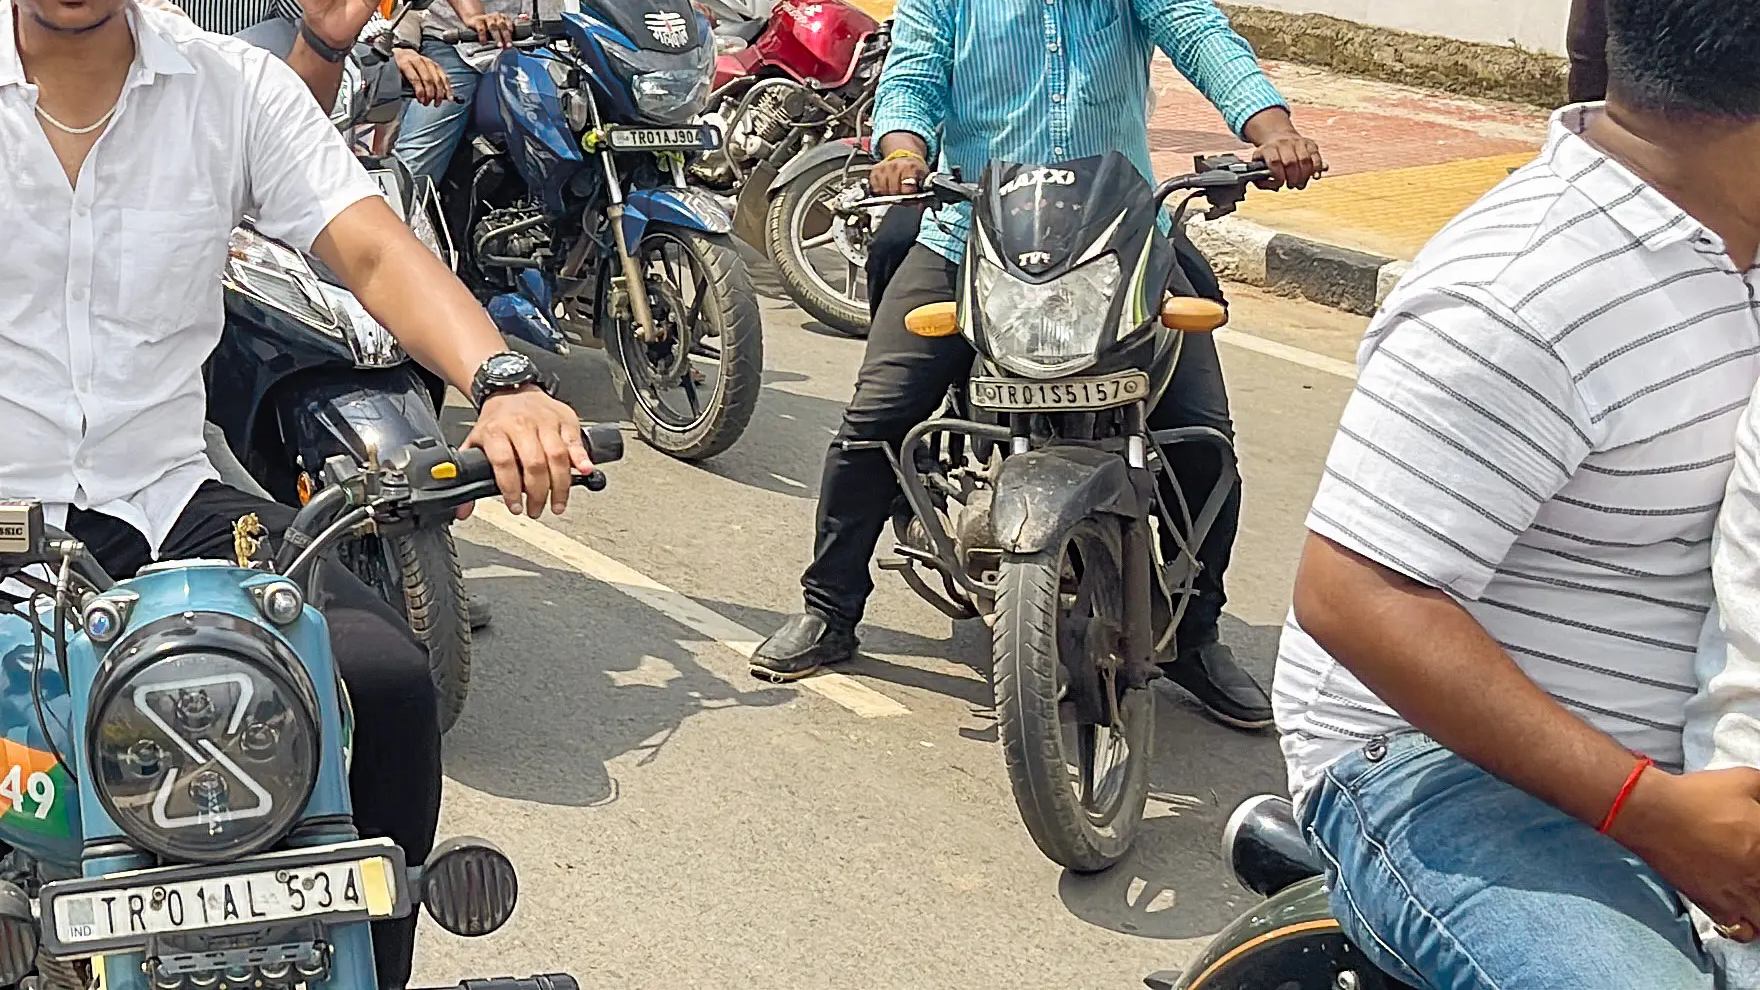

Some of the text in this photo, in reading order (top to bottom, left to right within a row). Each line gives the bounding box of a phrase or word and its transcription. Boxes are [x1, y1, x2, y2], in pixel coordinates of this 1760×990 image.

[995, 380, 1121, 404] TR01S5157
[0, 764, 56, 820] 49
[69, 925, 92, 939] IND
